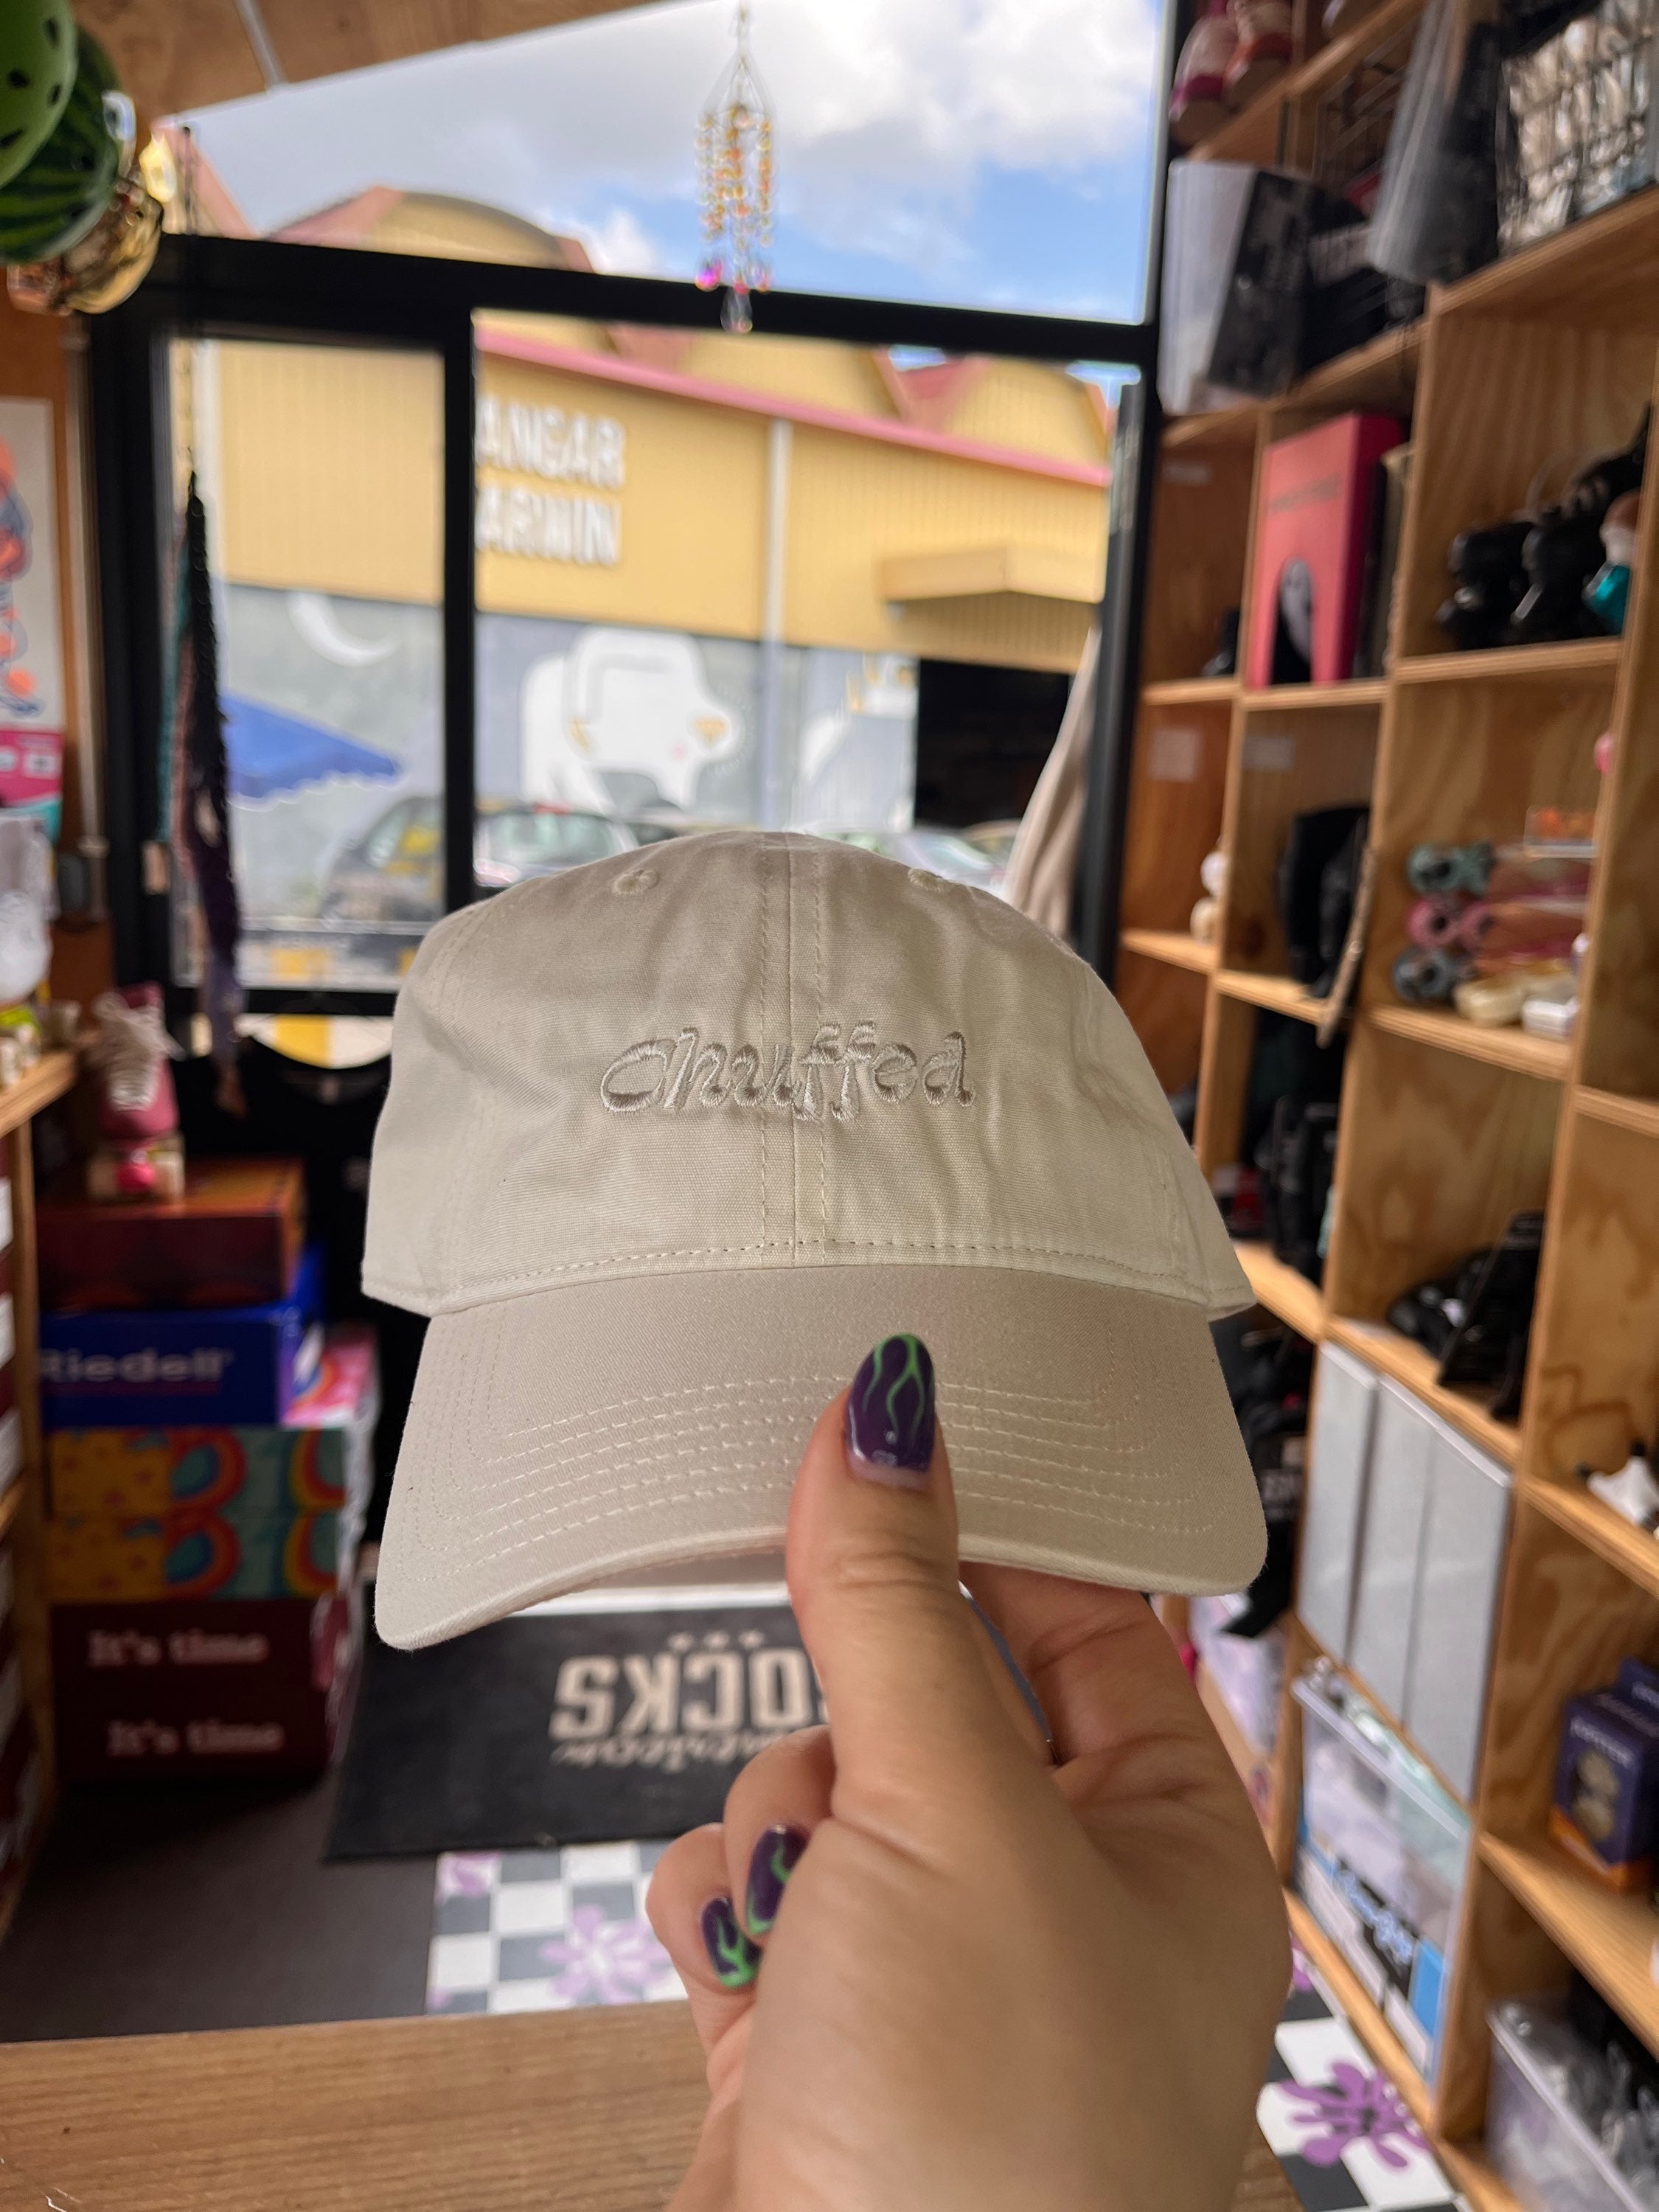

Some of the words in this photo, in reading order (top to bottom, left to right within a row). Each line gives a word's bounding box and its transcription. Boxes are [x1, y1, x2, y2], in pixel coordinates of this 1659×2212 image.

[476, 395, 626, 488] ANGAR
[476, 484, 620, 566] ARWIN
[600, 1020, 975, 1121] Chuffed
[168, 1628, 270, 1665] time
[186, 1717, 286, 1754] time
[549, 1646, 830, 1742] OCKS
